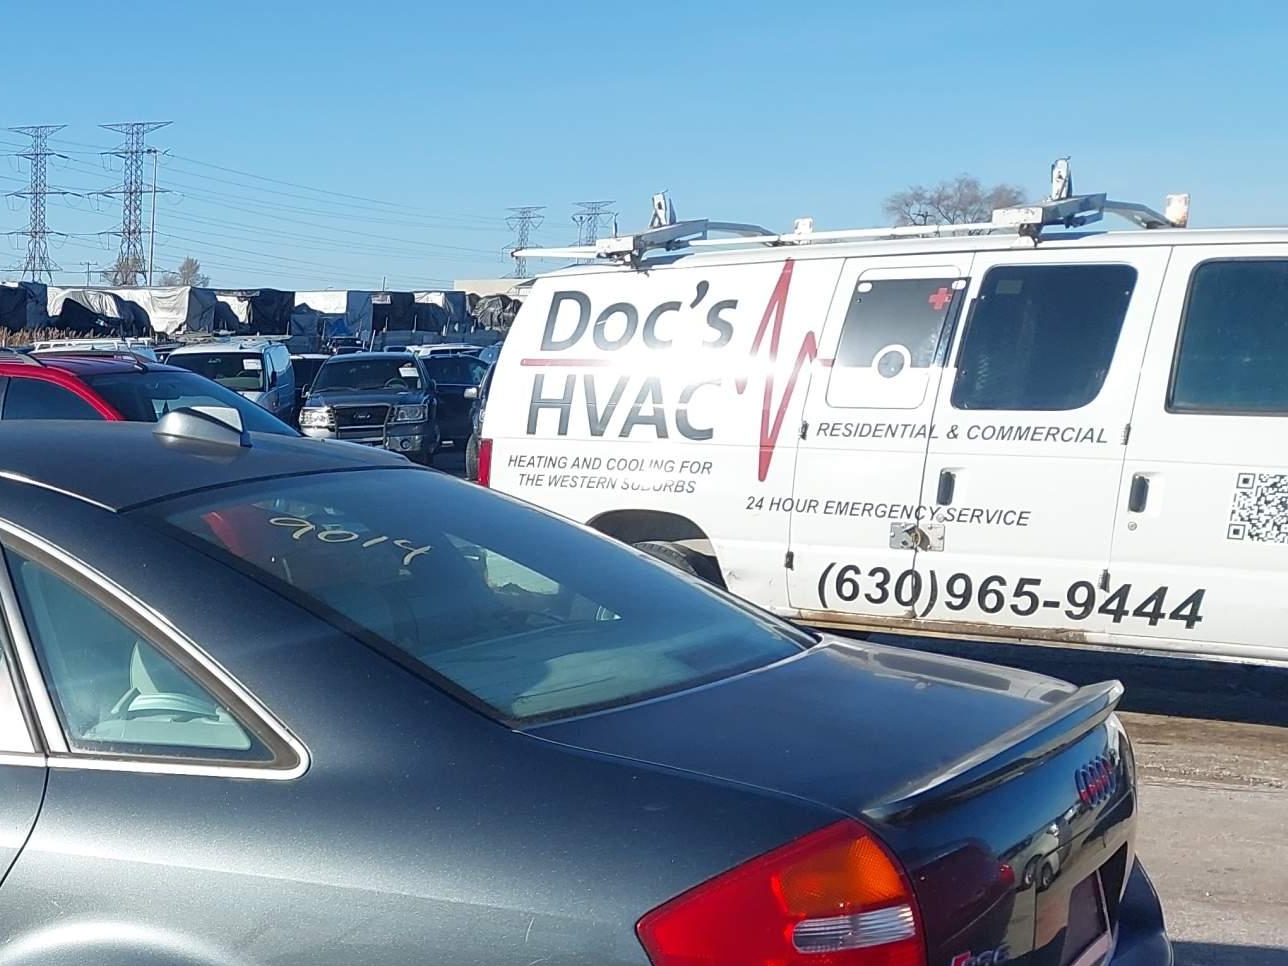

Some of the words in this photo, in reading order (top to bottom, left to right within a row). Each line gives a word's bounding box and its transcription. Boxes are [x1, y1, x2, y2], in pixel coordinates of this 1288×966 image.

[540, 280, 739, 352] Doc's
[526, 373, 721, 441] HVAC
[816, 422, 939, 439] RESIDENTIAL
[946, 424, 959, 440] &
[967, 425, 1108, 444] COMMERCIAL
[508, 454, 568, 469] HEATING
[570, 456, 602, 470] AND
[606, 458, 675, 473] COOLING
[678, 460, 713, 475] FOR
[519, 473, 545, 487] THE
[548, 474, 618, 490] WESTERN
[620, 477, 697, 494] SUURBS
[746, 496, 765, 511] 24
[768, 497, 819, 515] HOUR
[823, 500, 941, 521] EMERGENCY
[943, 507, 1031, 527] SERVICE
[269, 516, 432, 566] 9014
[817, 561, 1207, 631] (630)965-9444
